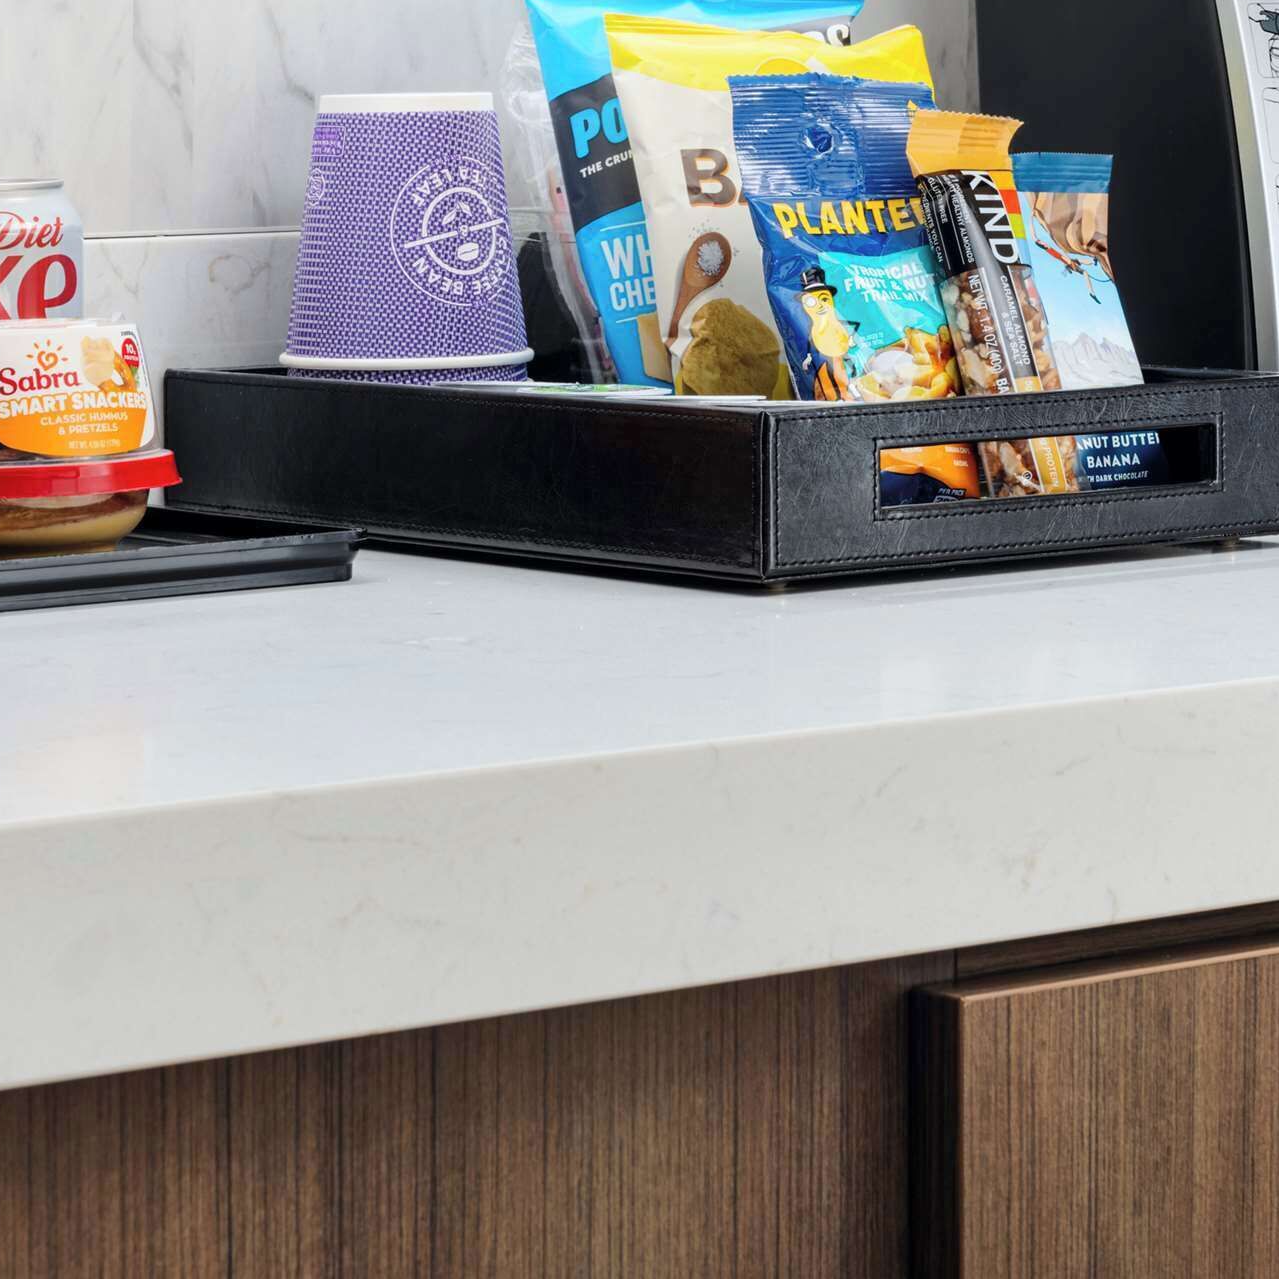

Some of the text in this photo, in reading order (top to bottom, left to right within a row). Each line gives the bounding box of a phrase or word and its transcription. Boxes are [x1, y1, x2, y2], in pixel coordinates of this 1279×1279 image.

[579, 160, 603, 178] THE
[410, 169, 452, 208] LEAF
[772, 197, 925, 240] PLANTE
[951, 193, 966, 226] HEALTHY
[960, 227, 975, 263] ALMONDS
[960, 170, 1019, 266] KIND
[412, 255, 464, 295] BEAN
[890, 280, 901, 292] &
[905, 274, 936, 291] NUT
[863, 288, 930, 303] TRAIL MIX
[967, 274, 986, 293] NET
[983, 334, 998, 350] OZ
[1000, 274, 1031, 365] CARAMEL ALMOND
[1003, 320, 1016, 340] SEA
[1009, 340, 1024, 367] SALT
[71, 390, 147, 410] SNACKERS
[40, 410, 128, 426] CLASSIC HUMMUS
[68, 423, 119, 434] PRETZELS
[1087, 453, 1141, 469] BANANA
[1096, 473, 1113, 483] DARK
[1113, 470, 1150, 481] CHOCOLATE
